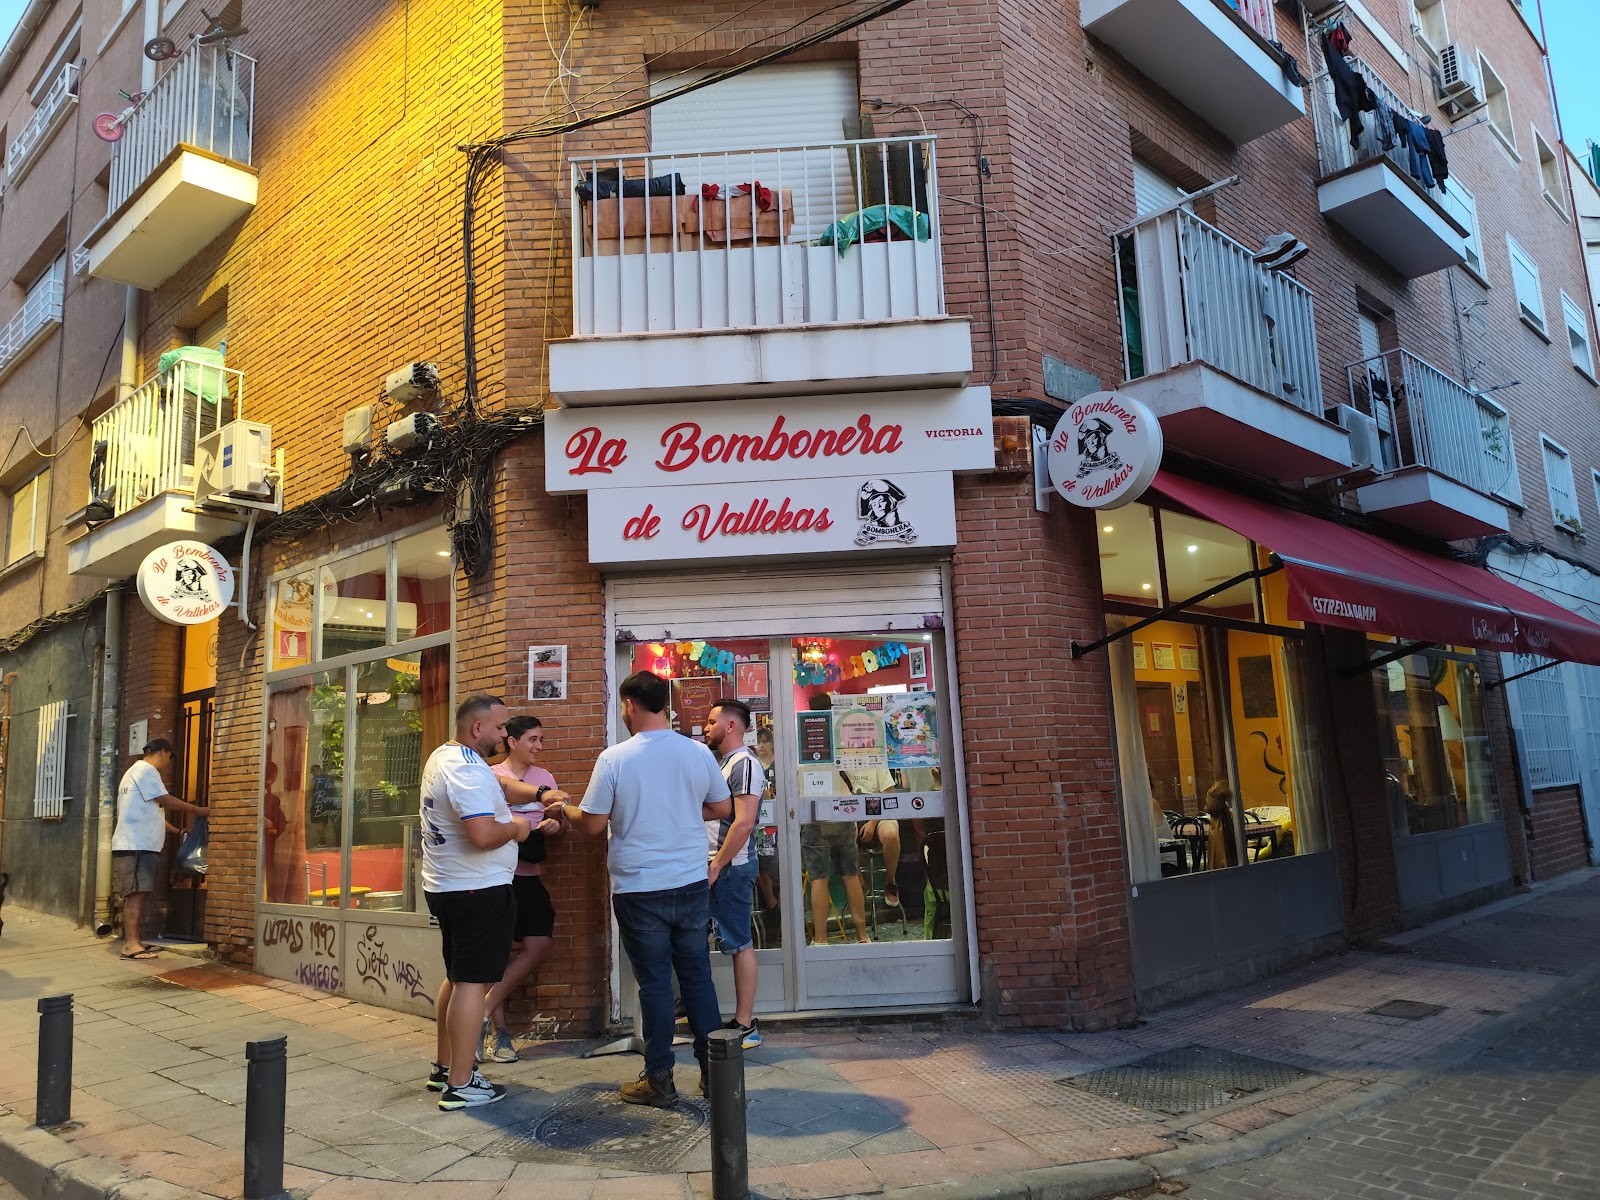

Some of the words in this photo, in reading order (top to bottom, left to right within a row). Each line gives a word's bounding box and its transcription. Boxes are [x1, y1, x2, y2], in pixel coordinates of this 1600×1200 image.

[925, 428, 983, 438] VICTORIA
[1053, 431, 1069, 453] La
[1071, 397, 1137, 434] Bombonera
[565, 426, 628, 475] La
[654, 414, 904, 472] Bombonera
[1061, 480, 1077, 492] de
[1081, 463, 1134, 500] Vallekas
[623, 503, 661, 541] de
[682, 497, 834, 543] Vallekas
[866, 524, 909, 535] BOMBONERA
[152, 558, 168, 574] La
[173, 545, 227, 582] Bombonera
[156, 595, 170, 606] de
[173, 601, 220, 619] Vallekas
[263, 918, 304, 954] ULTRAS
